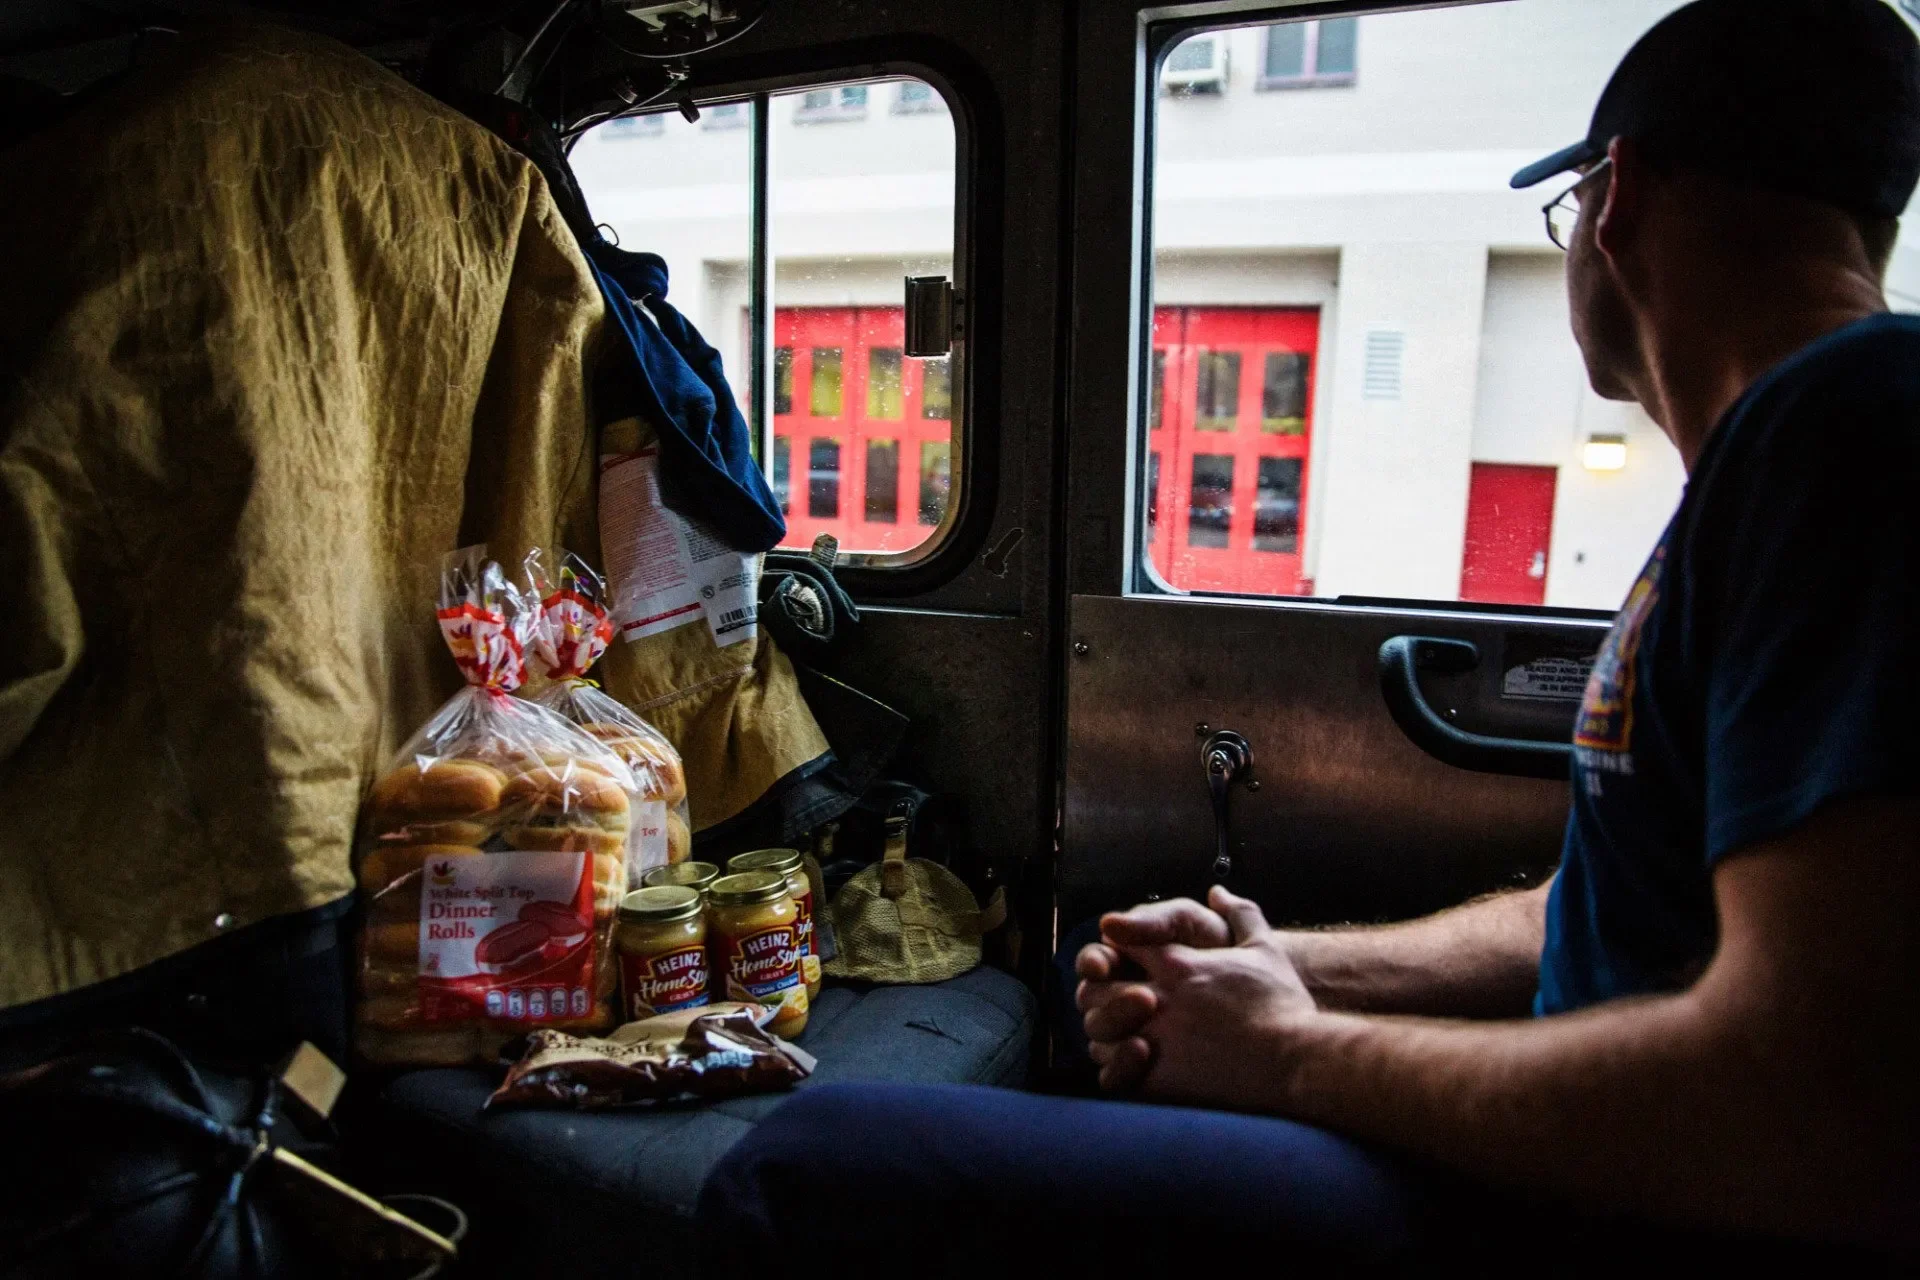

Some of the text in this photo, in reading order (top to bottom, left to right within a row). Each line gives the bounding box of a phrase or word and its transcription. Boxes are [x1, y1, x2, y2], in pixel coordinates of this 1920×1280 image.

[1558, 666, 1578, 674] AND
[1555, 675, 1585, 684] APPAR
[1549, 684, 1558, 692] IN
[429, 886, 535, 901] White Split Top
[429, 902, 499, 919] Dinner
[428, 921, 475, 940] Rolls
[747, 932, 790, 955] HEINZ
[657, 952, 702, 975] HEINZ
